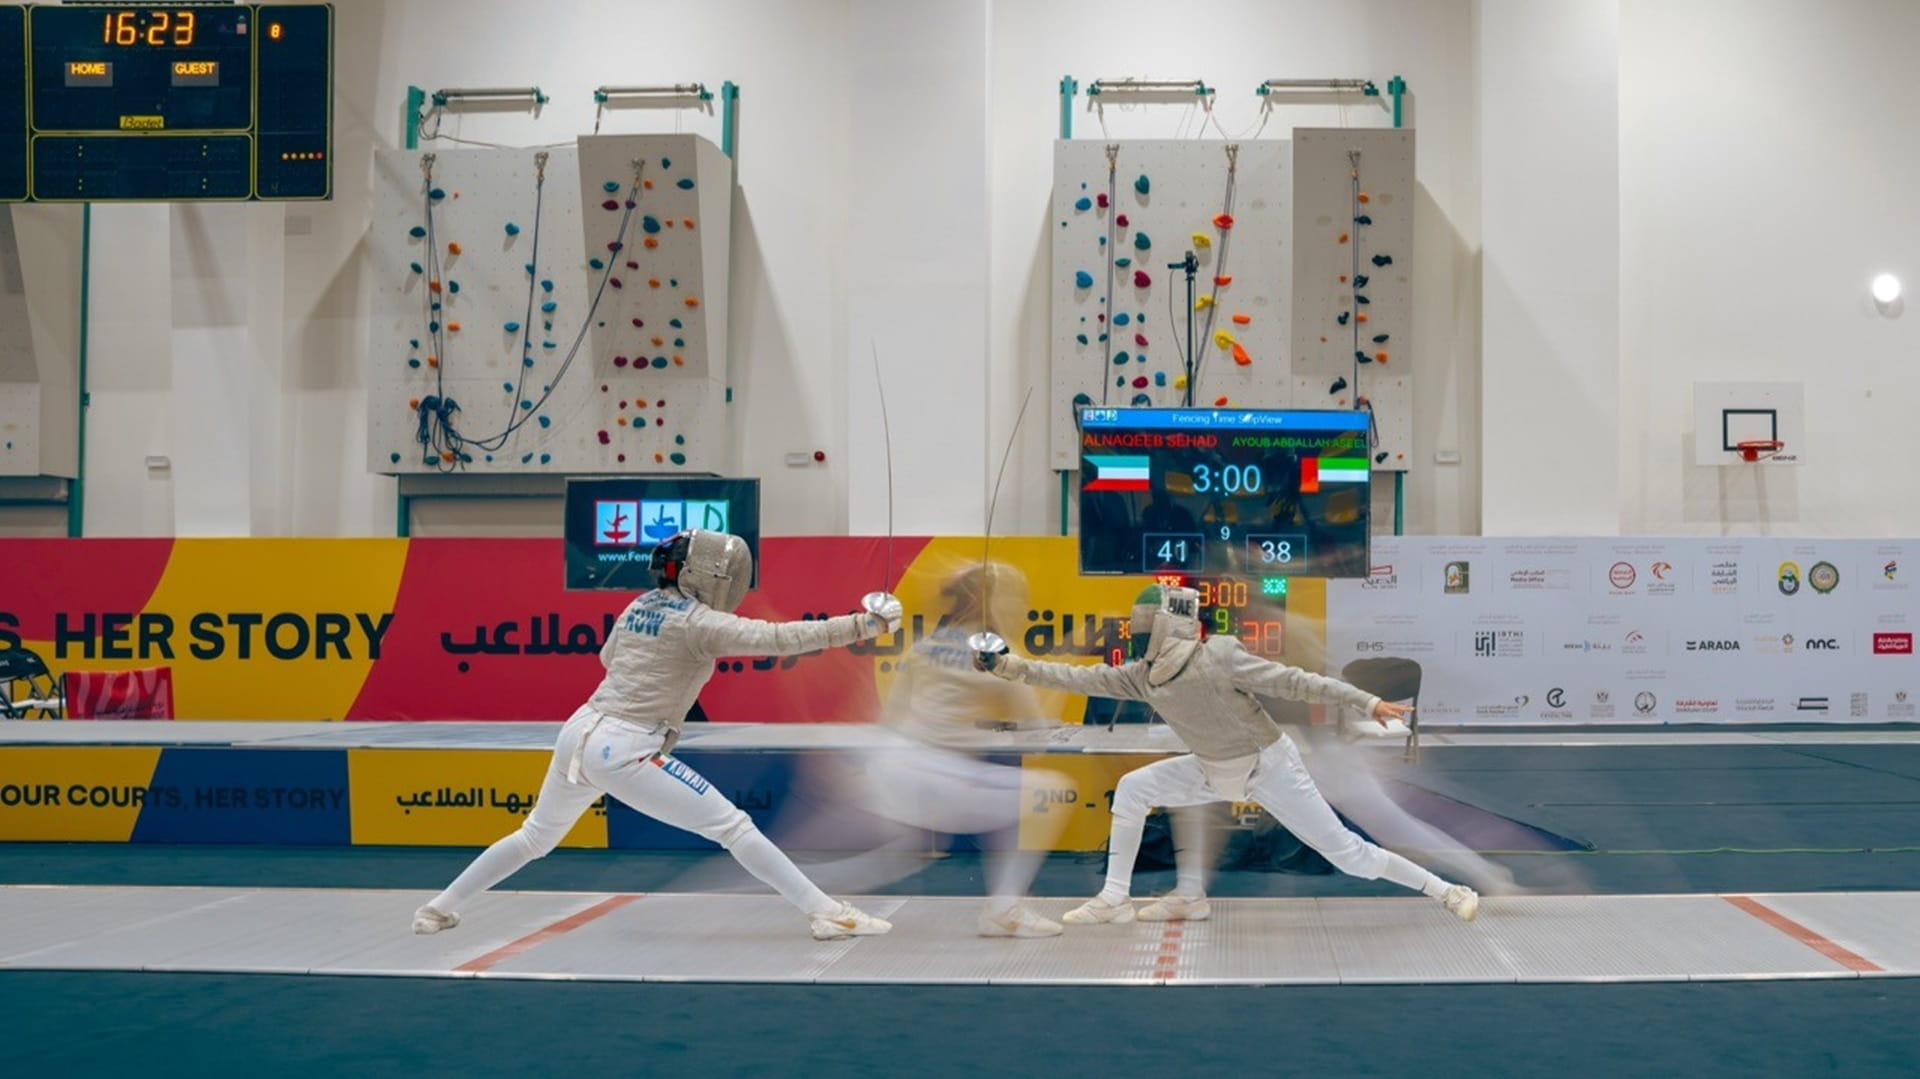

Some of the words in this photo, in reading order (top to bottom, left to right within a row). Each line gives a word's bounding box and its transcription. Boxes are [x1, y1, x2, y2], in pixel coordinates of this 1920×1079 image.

[104, 12, 195, 44] 16:23
[71, 64, 105, 75] HOME
[174, 63, 215, 75] GUEST
[1172, 413, 1210, 425] Fencing
[1192, 464, 1261, 493] 3:00
[1220, 526, 1231, 541] 9
[1157, 540, 1187, 563] 41
[1261, 541, 1292, 564] 38
[55, 612, 176, 660] HER
[189, 612, 395, 660] STORY
[1698, 641, 1741, 651] ARADA
[667, 760, 711, 795] KUWAIT
[2, 785, 60, 807] OUR
[195, 788, 249, 809] HER
[254, 788, 345, 809] STORY
[396, 787, 484, 815] الملاعب
